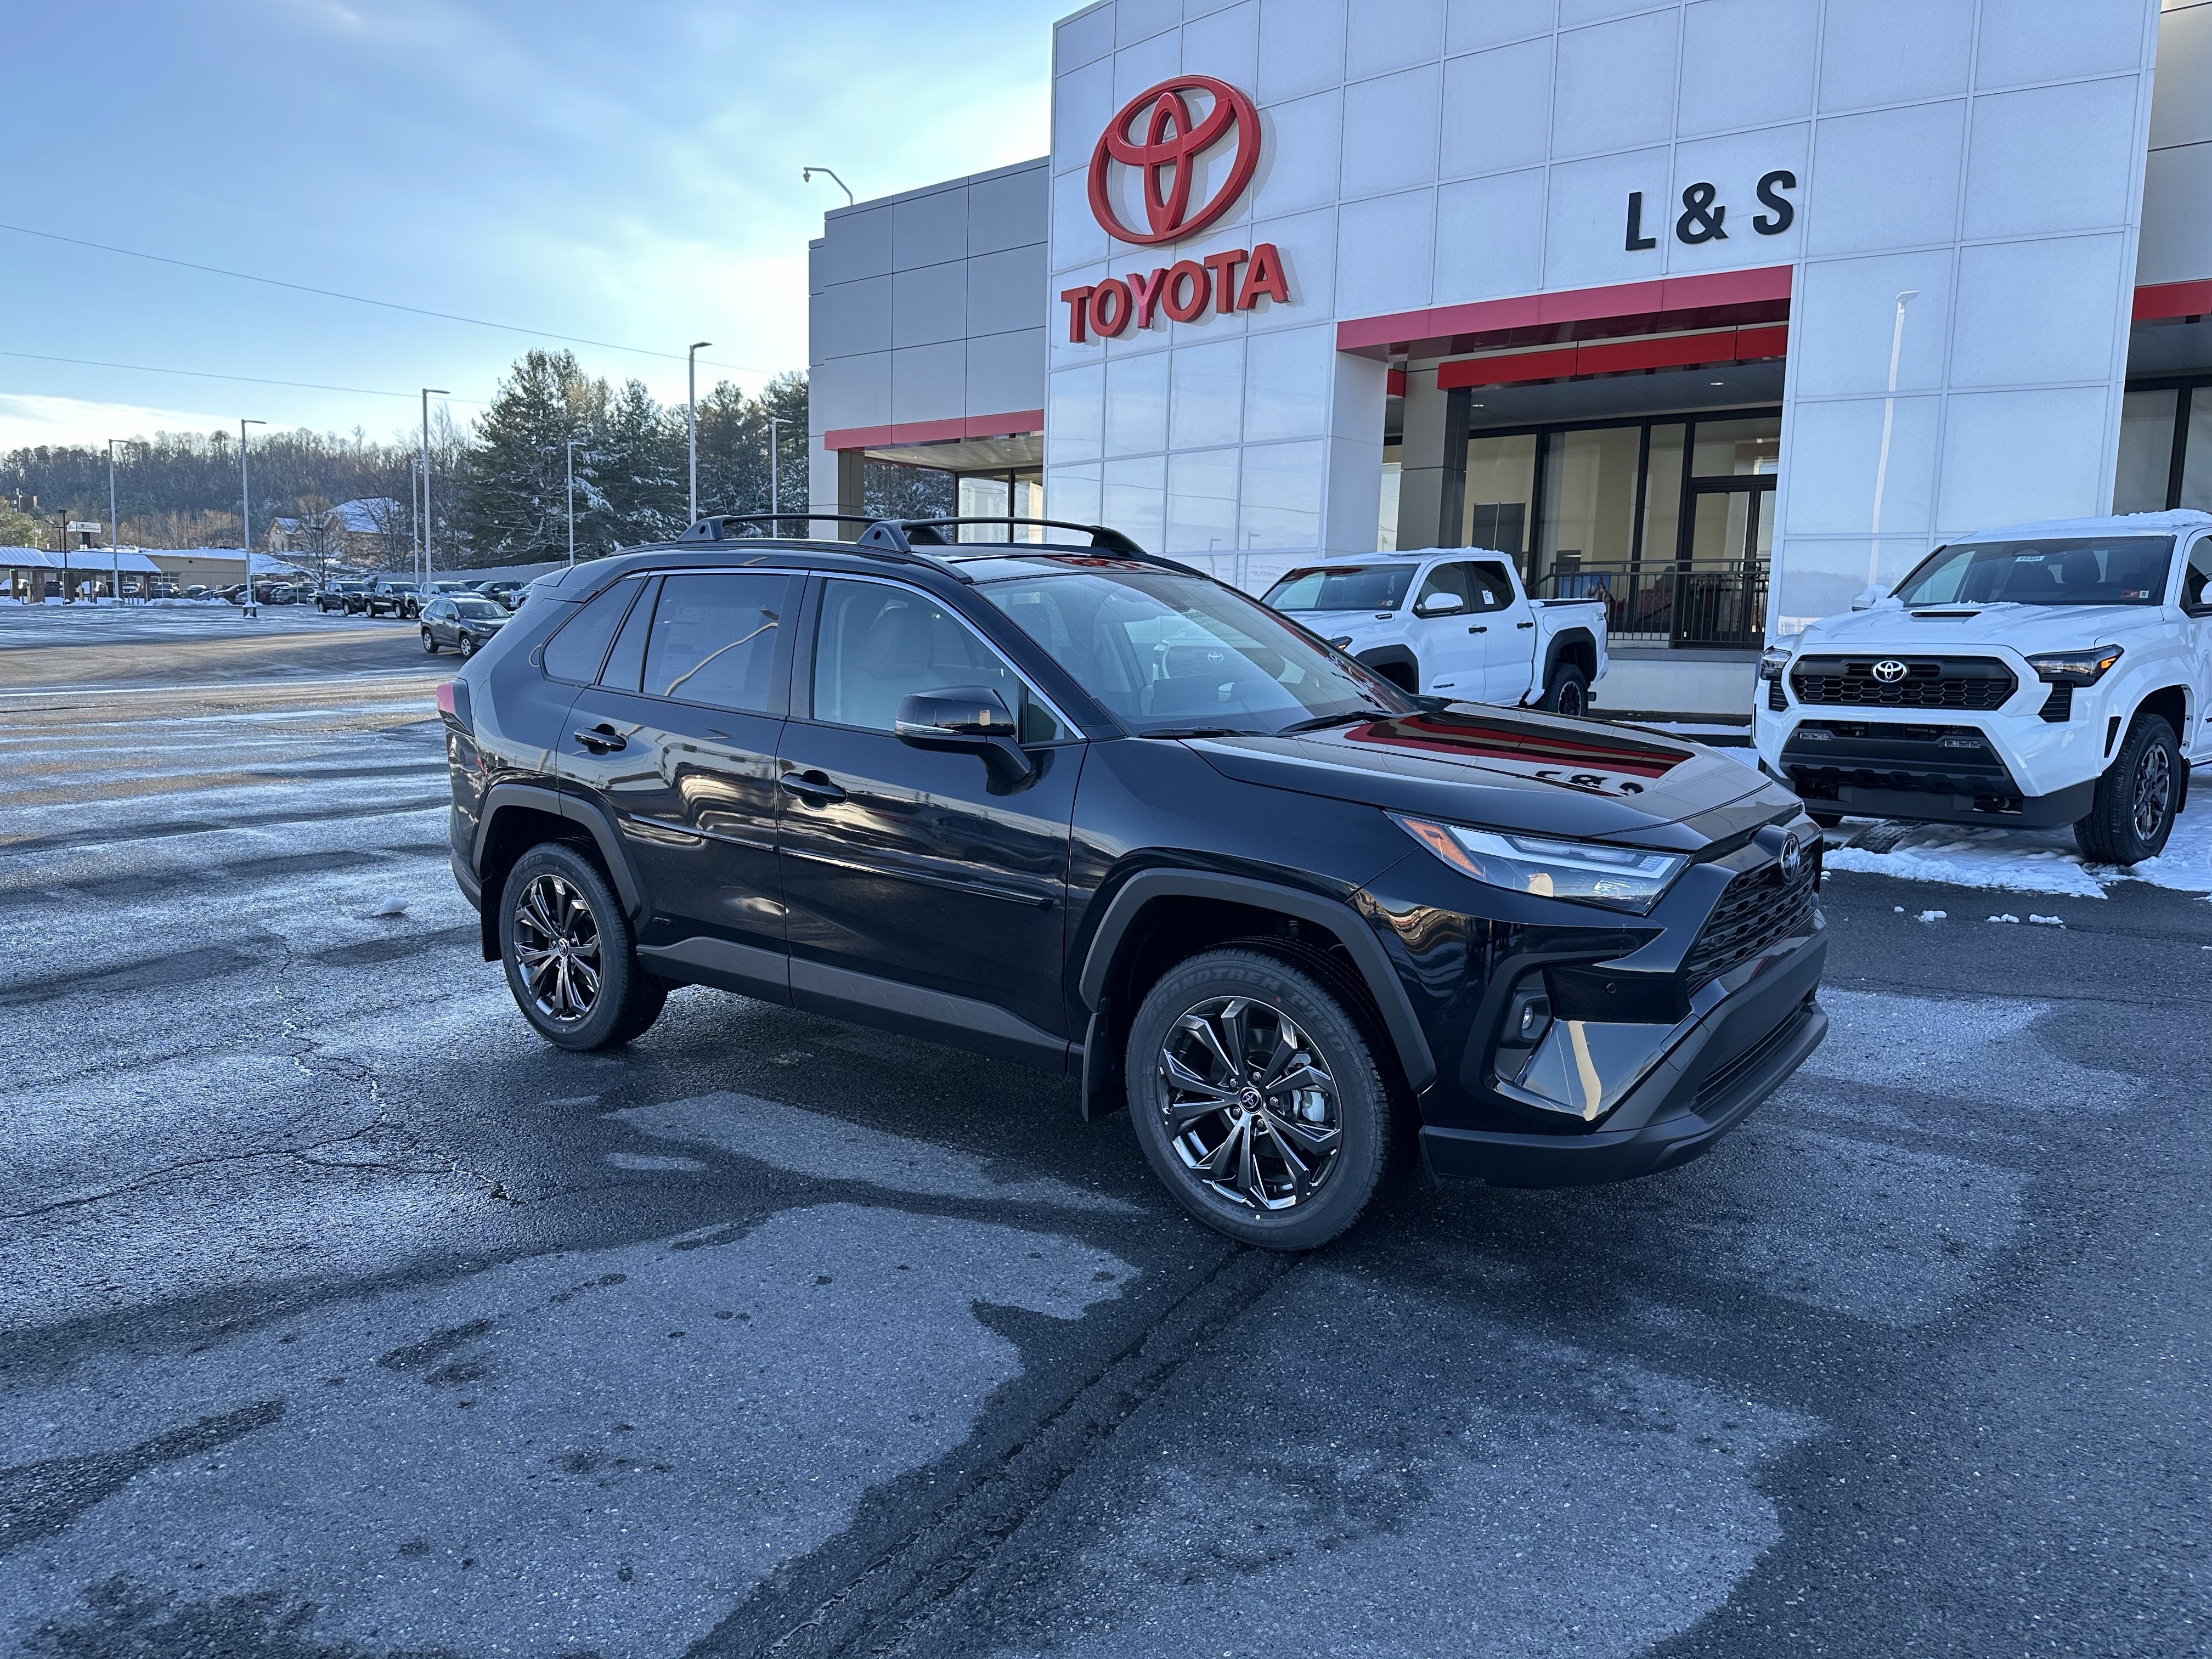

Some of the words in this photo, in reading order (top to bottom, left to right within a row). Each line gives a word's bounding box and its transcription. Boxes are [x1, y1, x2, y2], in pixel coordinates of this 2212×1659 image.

[1626, 191, 1656, 251] L
[1676, 182, 1729, 244] &
[1753, 170, 1796, 235] S
[1061, 244, 1292, 343] TOYOTA
